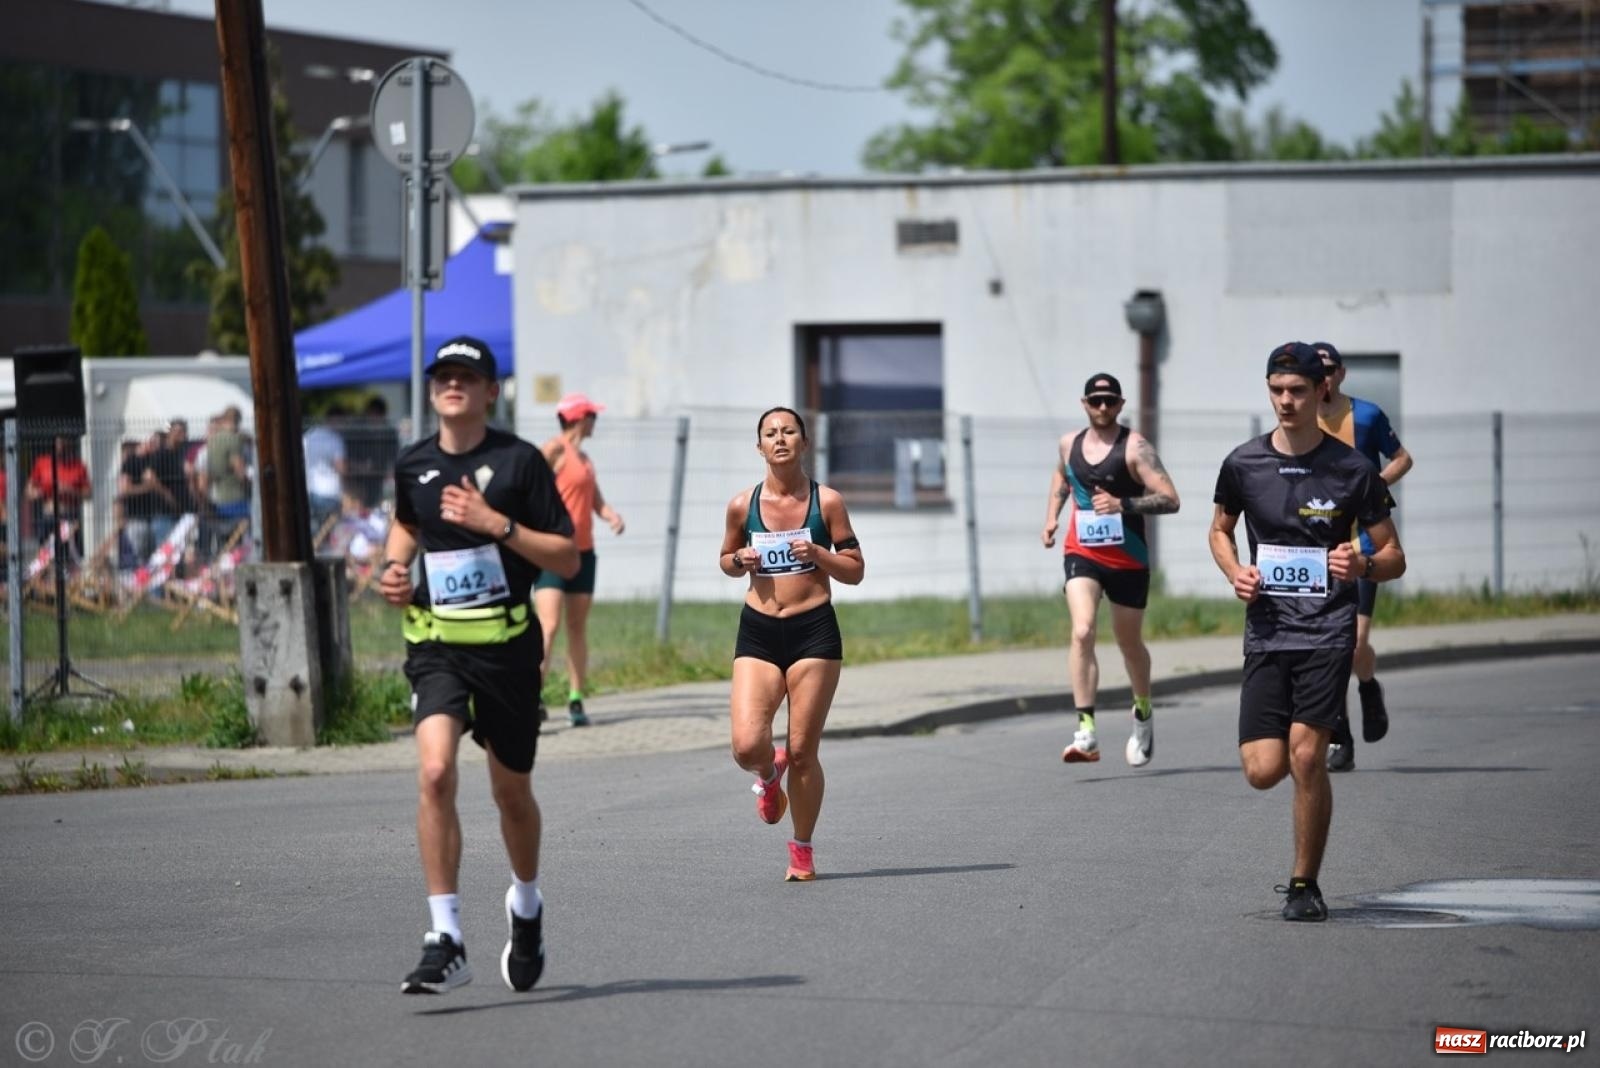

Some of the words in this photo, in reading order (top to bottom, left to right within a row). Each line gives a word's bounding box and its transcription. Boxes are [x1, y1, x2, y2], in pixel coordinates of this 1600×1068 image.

[1087, 525, 1110, 536] 041
[768, 549, 797, 565] 016
[445, 570, 487, 593] 042
[1273, 566, 1310, 583] 038
